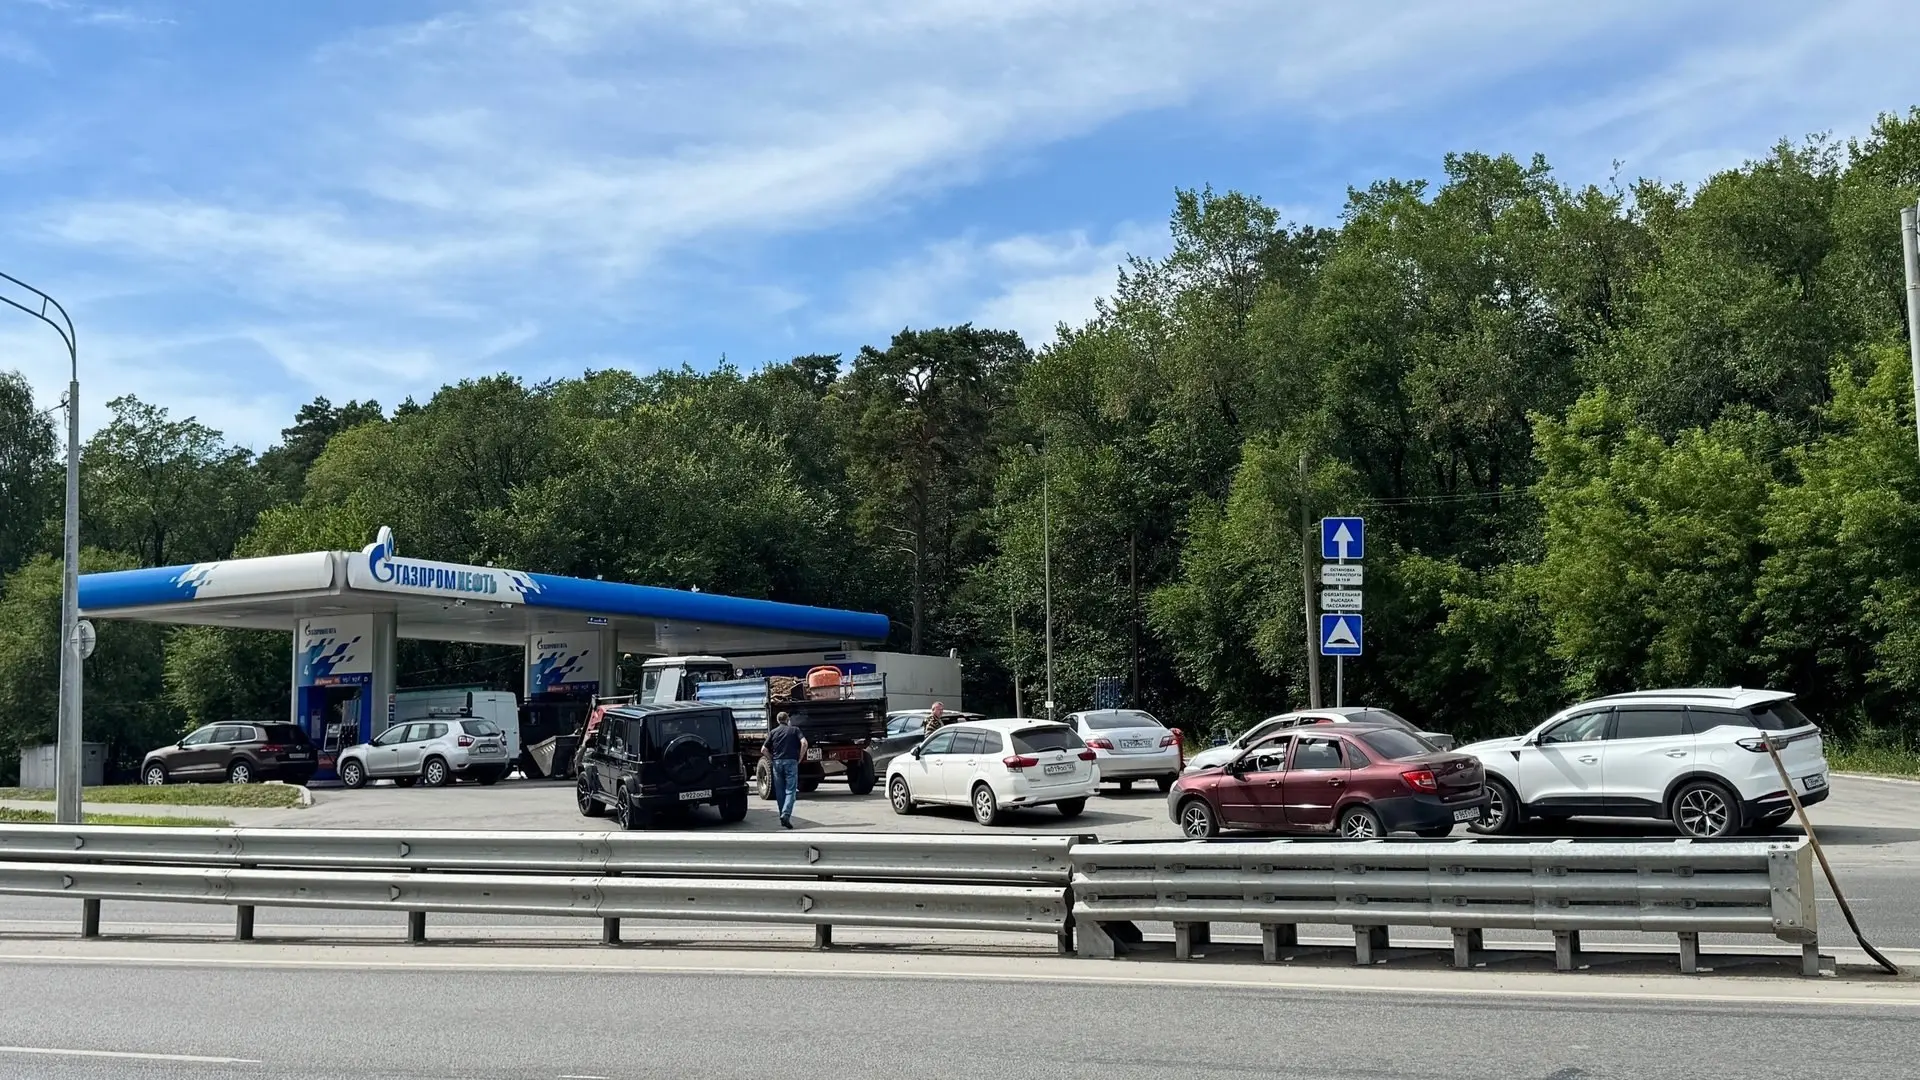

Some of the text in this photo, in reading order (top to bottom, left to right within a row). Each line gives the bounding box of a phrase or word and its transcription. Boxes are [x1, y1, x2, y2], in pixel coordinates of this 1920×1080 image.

[394, 564, 497, 594] ГАЗПРОМНЕФТЬ
[304, 665, 309, 675] 4
[536, 674, 541, 684] 2
